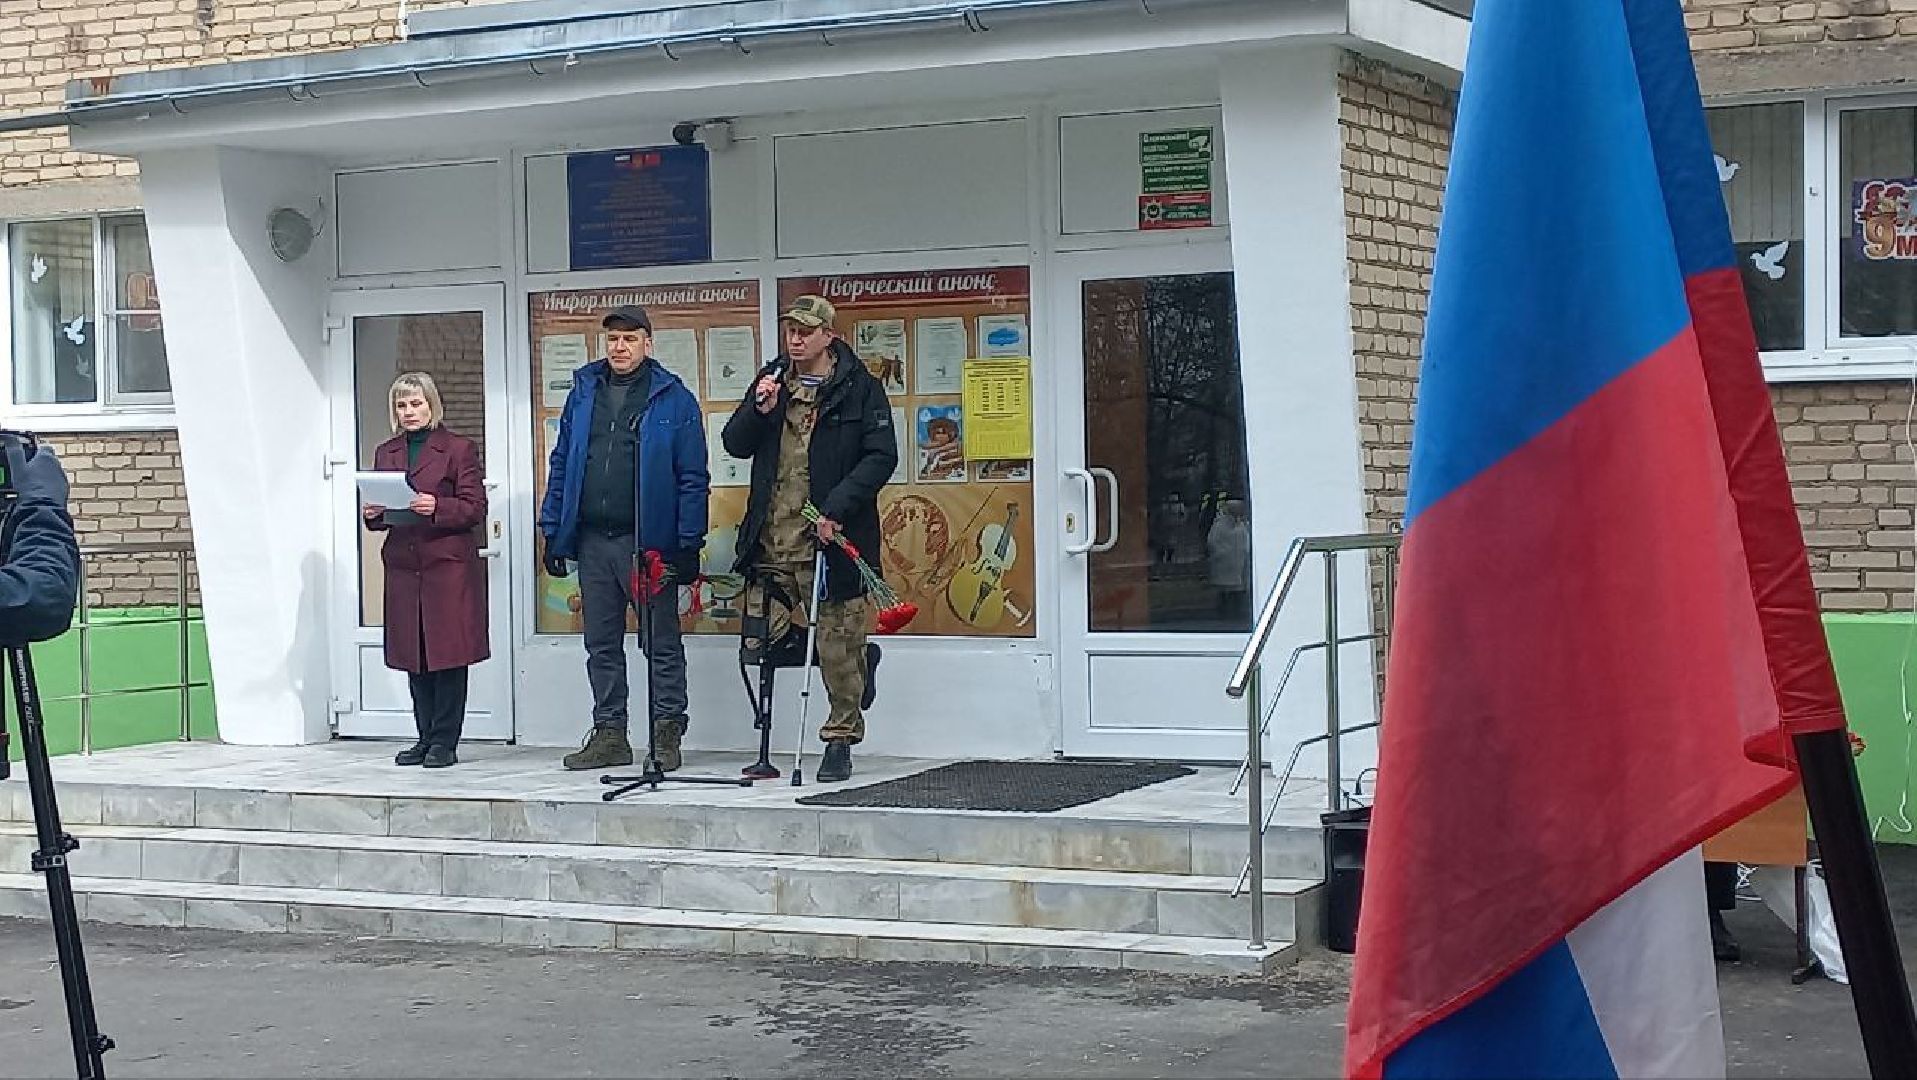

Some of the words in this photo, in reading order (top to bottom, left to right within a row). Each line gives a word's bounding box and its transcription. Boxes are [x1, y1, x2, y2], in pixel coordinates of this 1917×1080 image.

[543, 287, 696, 314] Информационный
[700, 286, 749, 302] анонс
[818, 272, 934, 302] Творческий
[938, 274, 998, 291] анонс
